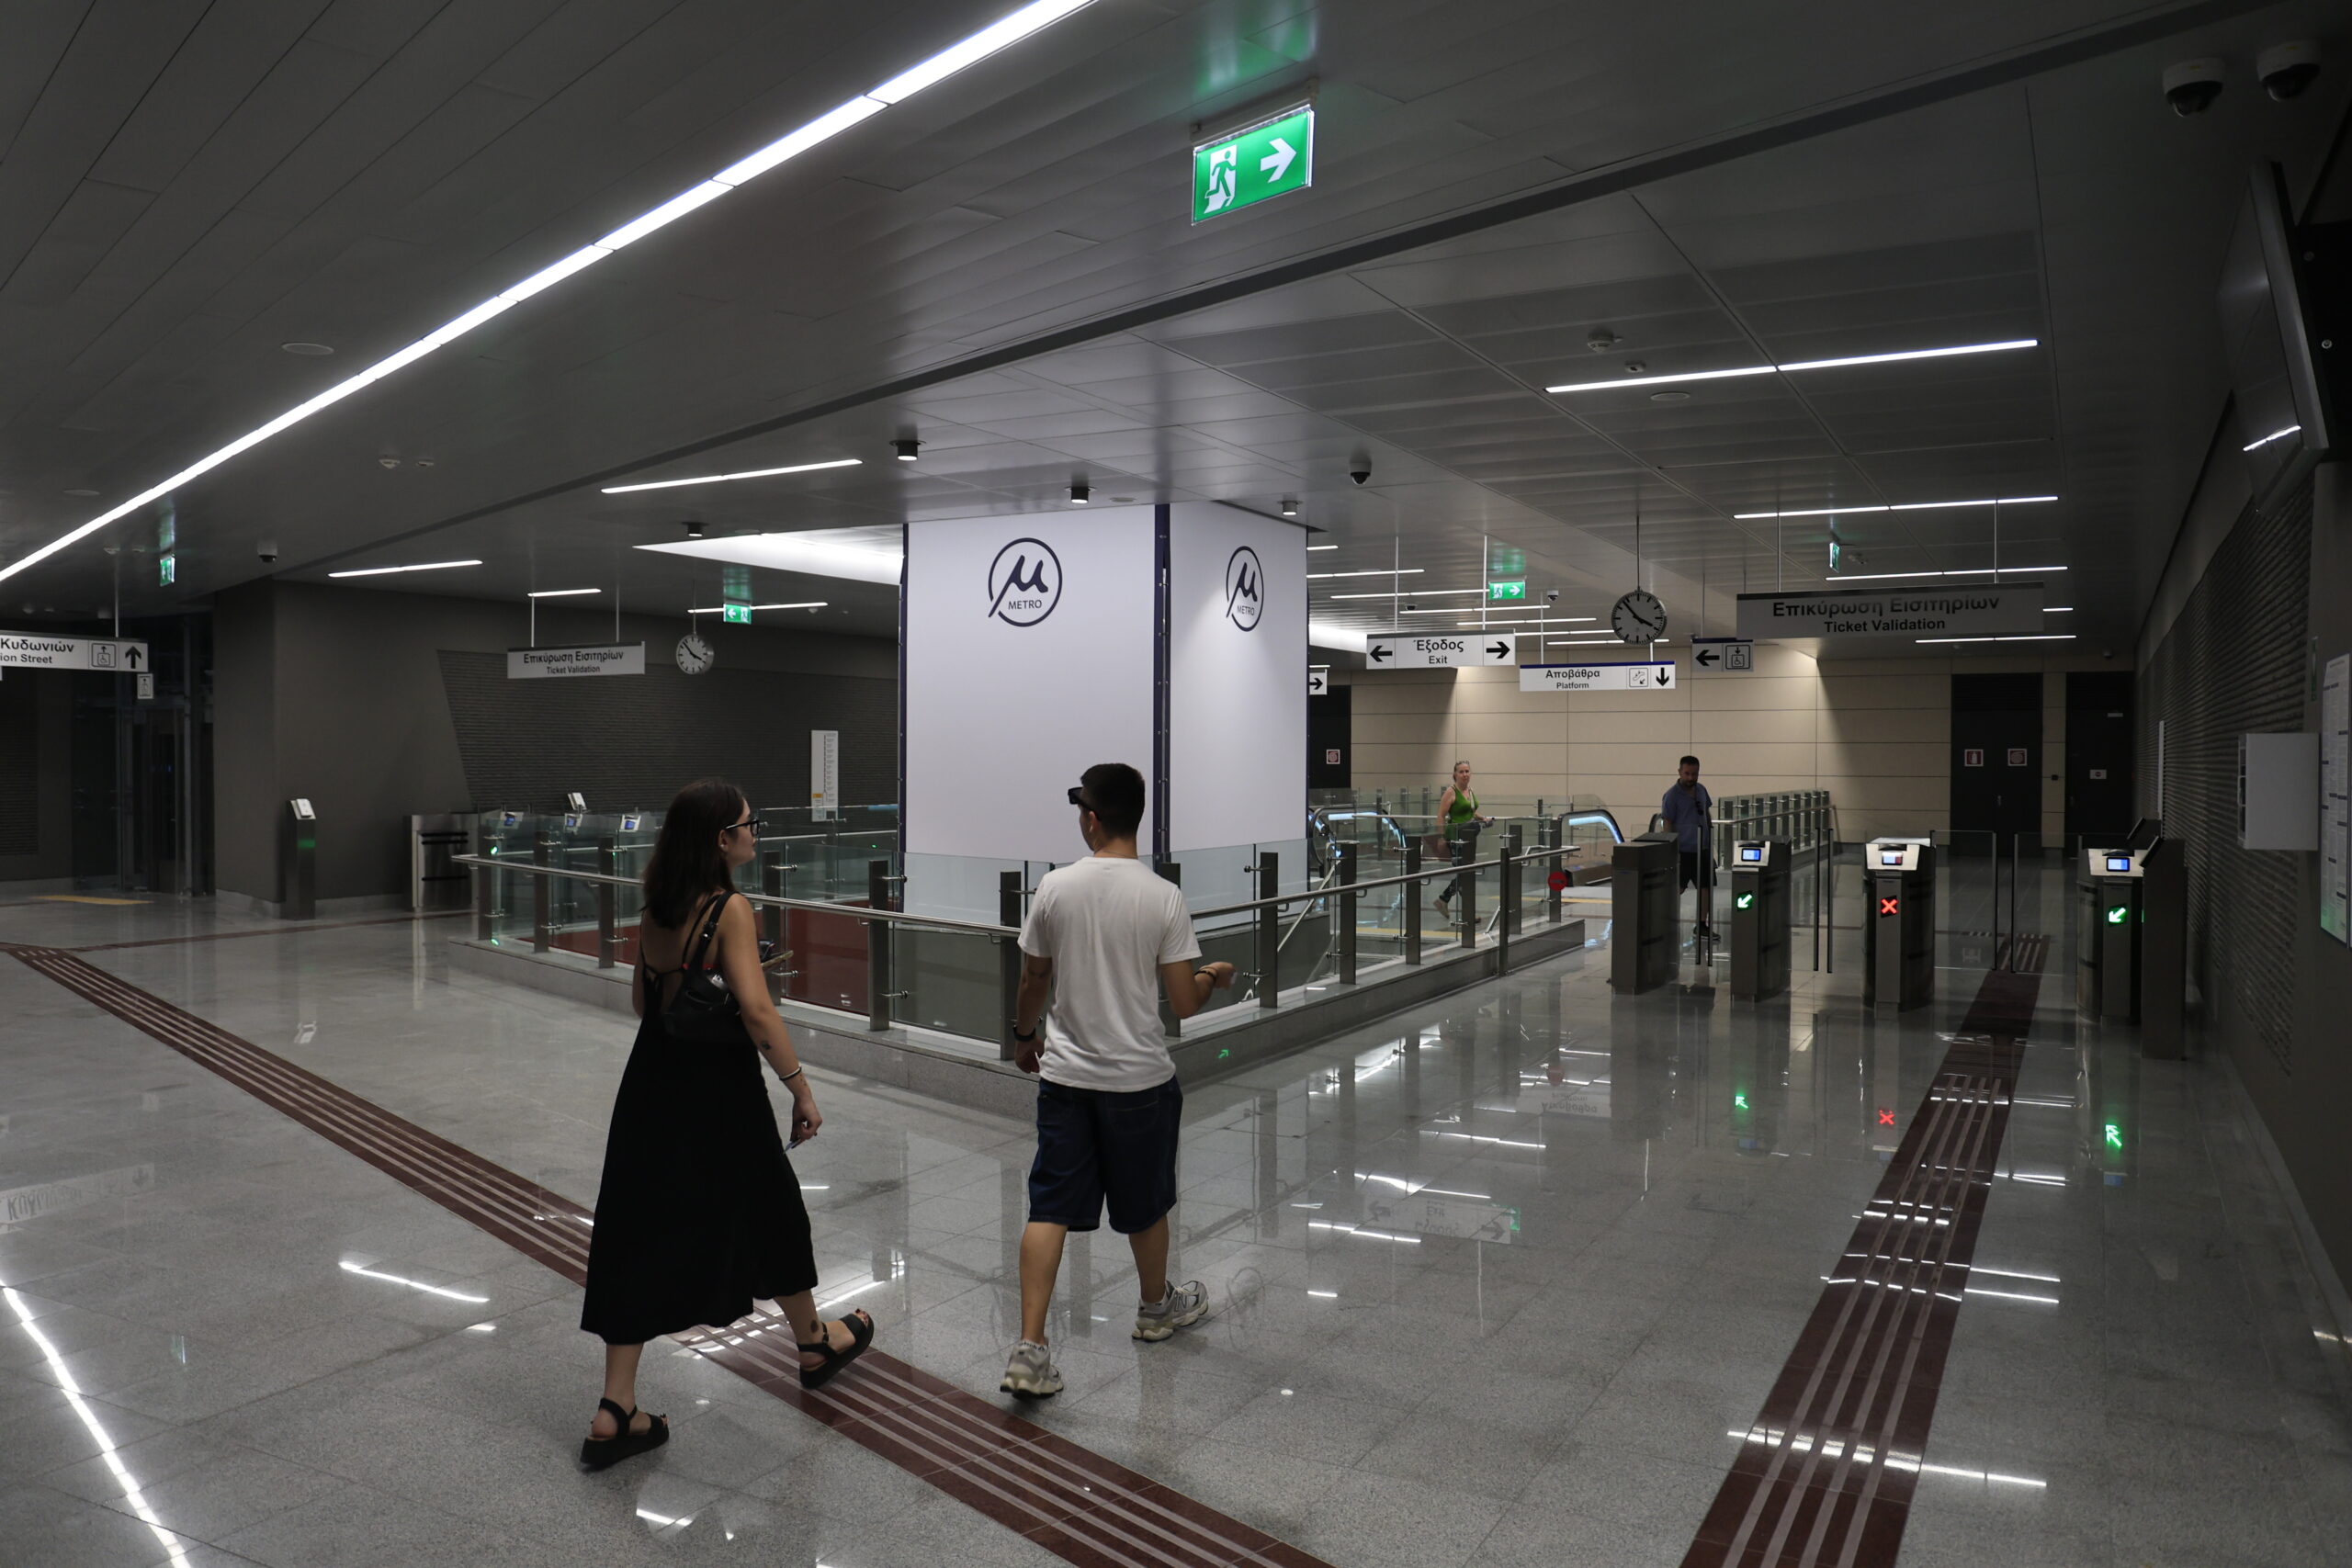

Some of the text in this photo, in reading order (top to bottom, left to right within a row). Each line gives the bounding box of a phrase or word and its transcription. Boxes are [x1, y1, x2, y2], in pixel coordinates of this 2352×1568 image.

[1008, 599, 1043, 610] METRO
[1772, 596, 2000, 619] Επικύρωση Εισιτηρίων
[1237, 605, 1255, 616] METRO
[1824, 617, 1946, 633] Ticket Validation
[0, 637, 74, 653] Κυδωνιών
[1413, 639, 1464, 653] Έξοδος
[20, 653, 52, 664] Street
[523, 649, 625, 664] Επικύρωση Εισιτηρίων
[1429, 655, 1448, 664] Exit
[547, 666, 601, 674] Ticket Validation
[1545, 669, 1600, 680] Αποβάθρα
